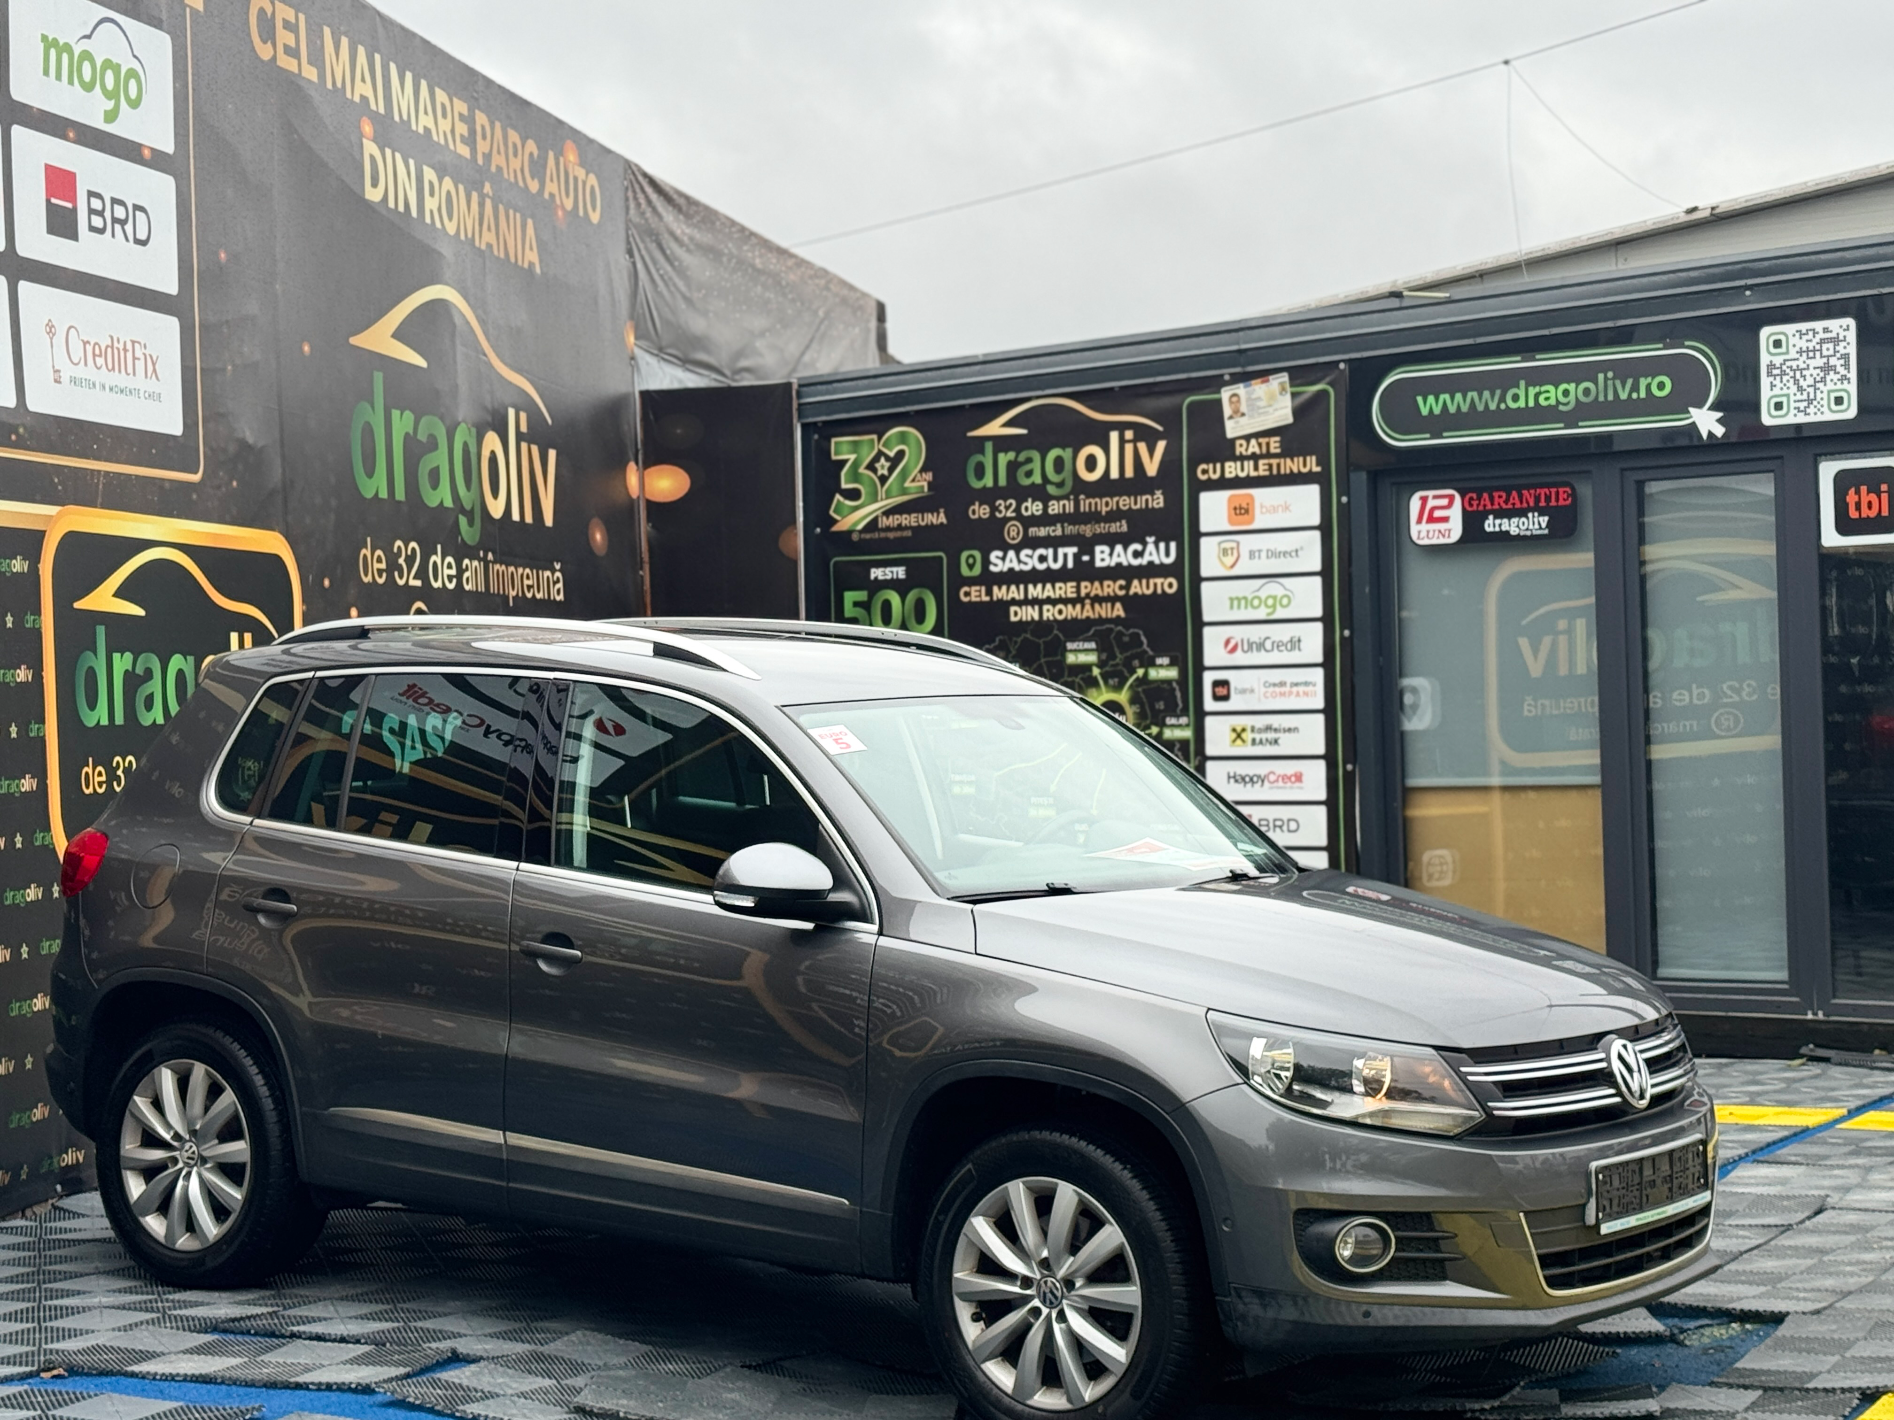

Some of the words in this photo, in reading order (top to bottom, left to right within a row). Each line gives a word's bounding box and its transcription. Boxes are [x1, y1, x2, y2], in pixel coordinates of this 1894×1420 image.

[40, 33, 143, 124] mogo
[249, 0, 318, 83] CEL
[323, 25, 385, 115] MAI
[389, 61, 471, 160] MARE
[475, 109, 540, 194] PARC
[543, 150, 601, 225] AUTO
[86, 189, 151, 247] BRD
[362, 137, 418, 219] DIN
[423, 164, 541, 275] ROMÂNIA
[65, 325, 161, 382] CreditFix
[69, 375, 97, 390] PRIETEN
[99, 381, 106, 393] IN
[109, 384, 141, 400] MOMENTE
[1416, 370, 1673, 417] www.dragoliv.ro
[351, 370, 557, 546] dragoliv
[1235, 436, 1281, 456] RATE
[829, 426, 927, 521] 32
[966, 429, 1167, 497] dragoliv
[1197, 463, 1221, 481] CU
[1224, 455, 1322, 478] BULETINUL
[914, 471, 933, 483] ANI
[969, 501, 990, 519] de
[995, 499, 1016, 517] 32
[1021, 498, 1043, 516] de
[1048, 495, 1074, 514] ani
[1079, 490, 1164, 515] împreună
[1232, 503, 1250, 516] tbi
[1260, 501, 1291, 515] bank
[1416, 493, 1456, 525] 12
[1463, 487, 1573, 511] GARANTIE
[1846, 483, 1890, 520] tbi
[878, 508, 947, 529] ÎMPREUNĂ
[1028, 522, 1062, 538] marcă
[1484, 512, 1549, 536] dragoliv
[1416, 528, 1453, 541] LUNI
[989, 546, 1078, 573] SASCUT
[1095, 536, 1177, 568] BACĂU
[1222, 546, 1235, 557] BT
[1249, 549, 1263, 560] BT
[359, 537, 387, 585] de
[393, 540, 422, 587] 32
[429, 544, 457, 590] de
[462, 550, 485, 593] ani
[488, 552, 564, 607] împreună
[870, 566, 906, 581] PESTE
[959, 585, 990, 602] CEL
[993, 583, 1024, 600] MAI
[1028, 581, 1077, 599] MARE
[1080, 579, 1126, 597] PARC
[1129, 577, 1178, 595] AUTO
[843, 587, 937, 635] 500
[1009, 605, 1039, 622] DIN
[1042, 599, 1125, 621] ROMÂNIA
[1228, 593, 1292, 617] mogo
[24, 610, 43, 632] dra
[1241, 636, 1302, 654] UniCredit
[1234, 686, 1256, 696] bank
[1263, 680, 1287, 689] Credit
[1290, 680, 1317, 689] pentru
[1263, 689, 1317, 699] COMPANII
[28, 720, 45, 738] dra
[1250, 724, 1299, 735] Raiffeisen
[832, 737, 852, 750] 5
[1251, 737, 1281, 747] BANK
[81, 757, 107, 795] de
[1227, 770, 1304, 788] HappyCredit
[1258, 818, 1300, 833] BRD
[3, 883, 43, 906] dragoliv
[9, 993, 50, 1018] dragoliv
